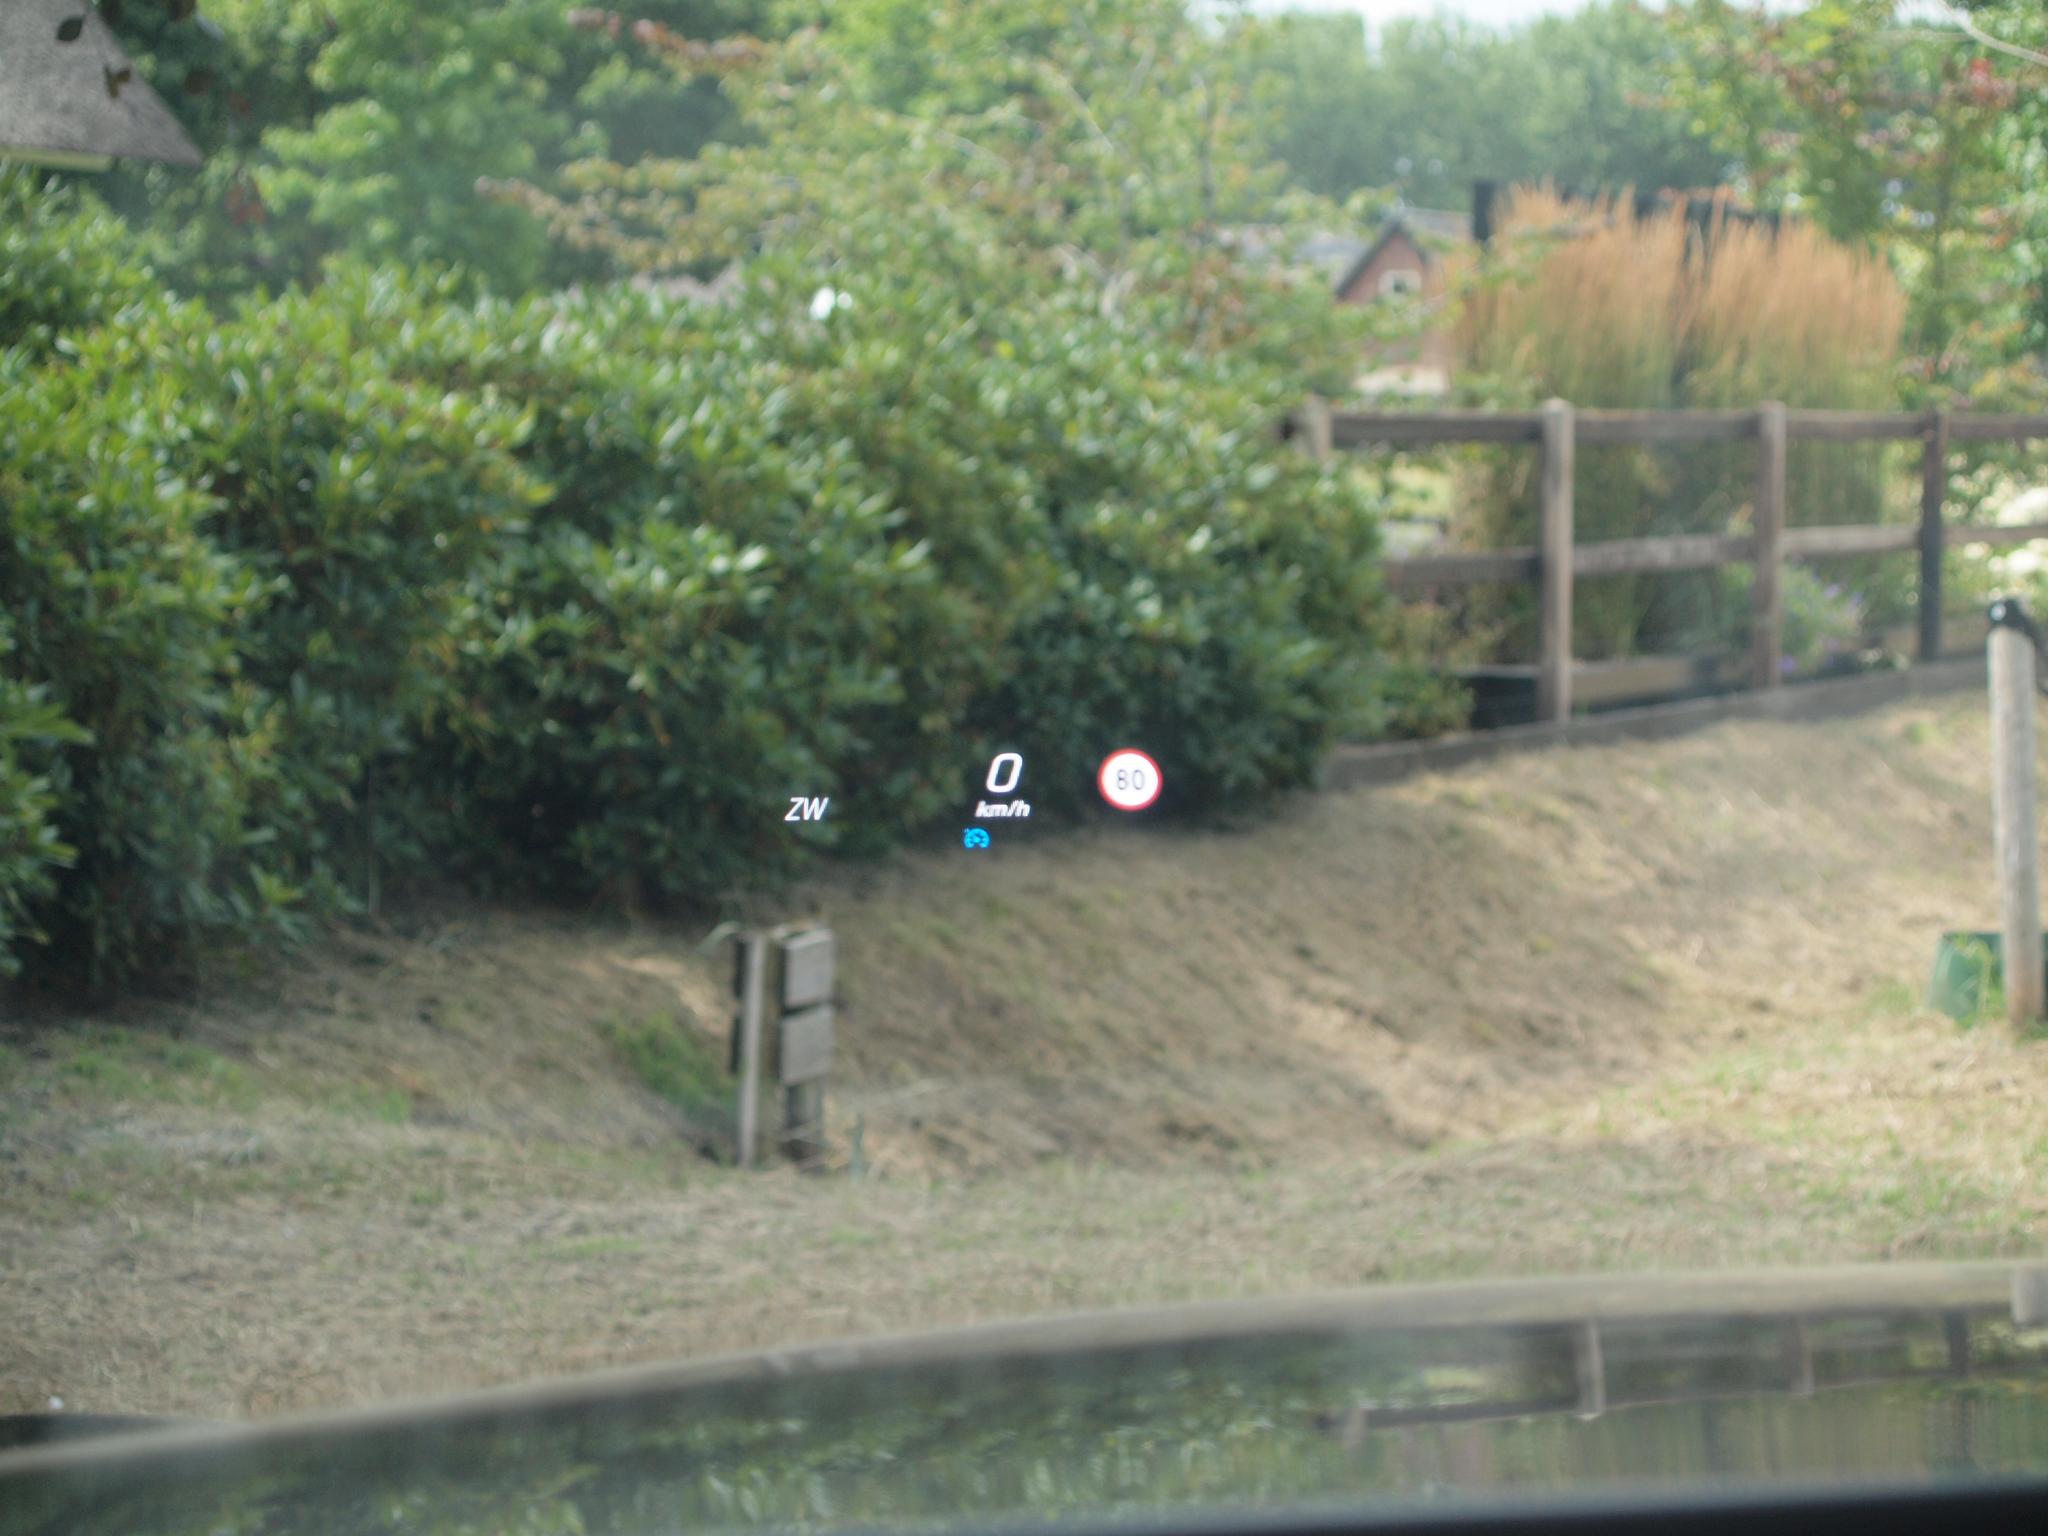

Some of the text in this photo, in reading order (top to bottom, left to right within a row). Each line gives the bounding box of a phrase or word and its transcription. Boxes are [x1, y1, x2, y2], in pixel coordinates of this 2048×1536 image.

[985, 752, 1023, 793] 0
[1117, 769, 1145, 790] 80
[784, 796, 829, 821] ZW
[975, 799, 1031, 818] km/h
